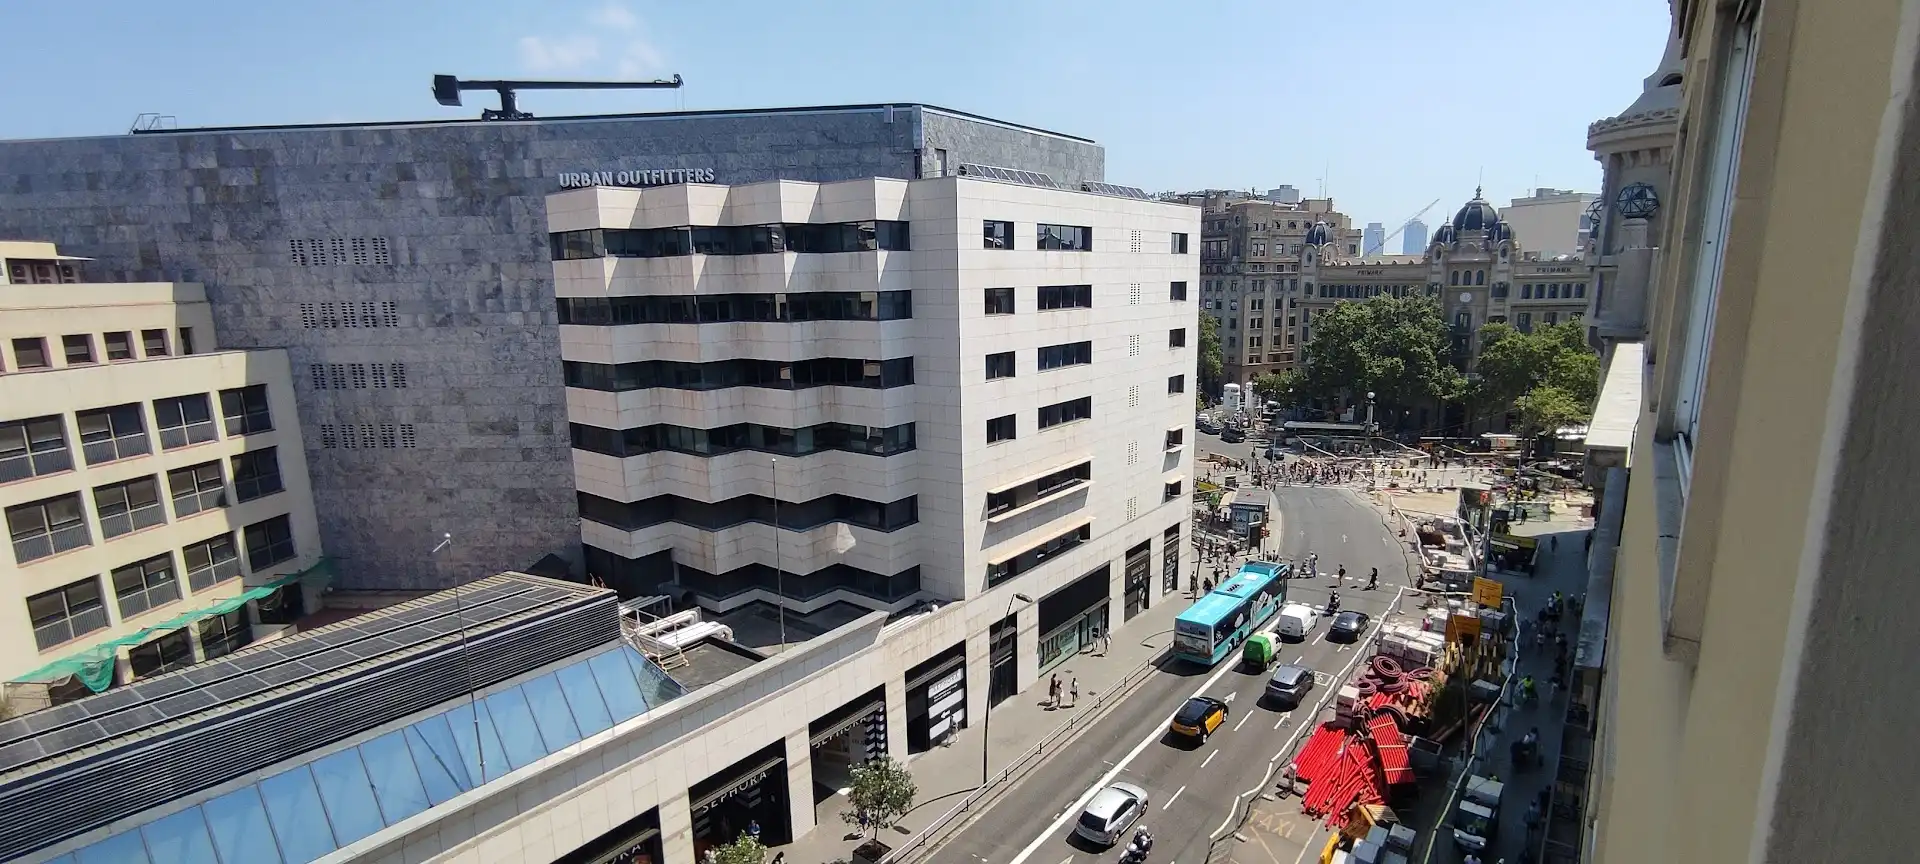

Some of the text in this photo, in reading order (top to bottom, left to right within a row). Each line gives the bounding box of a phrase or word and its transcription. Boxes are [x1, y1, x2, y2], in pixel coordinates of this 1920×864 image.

[559, 167, 715, 188] URBAN OUTFITTERS
[702, 771, 767, 813] SEPHORA
[1248, 809, 1296, 839] TAXI
